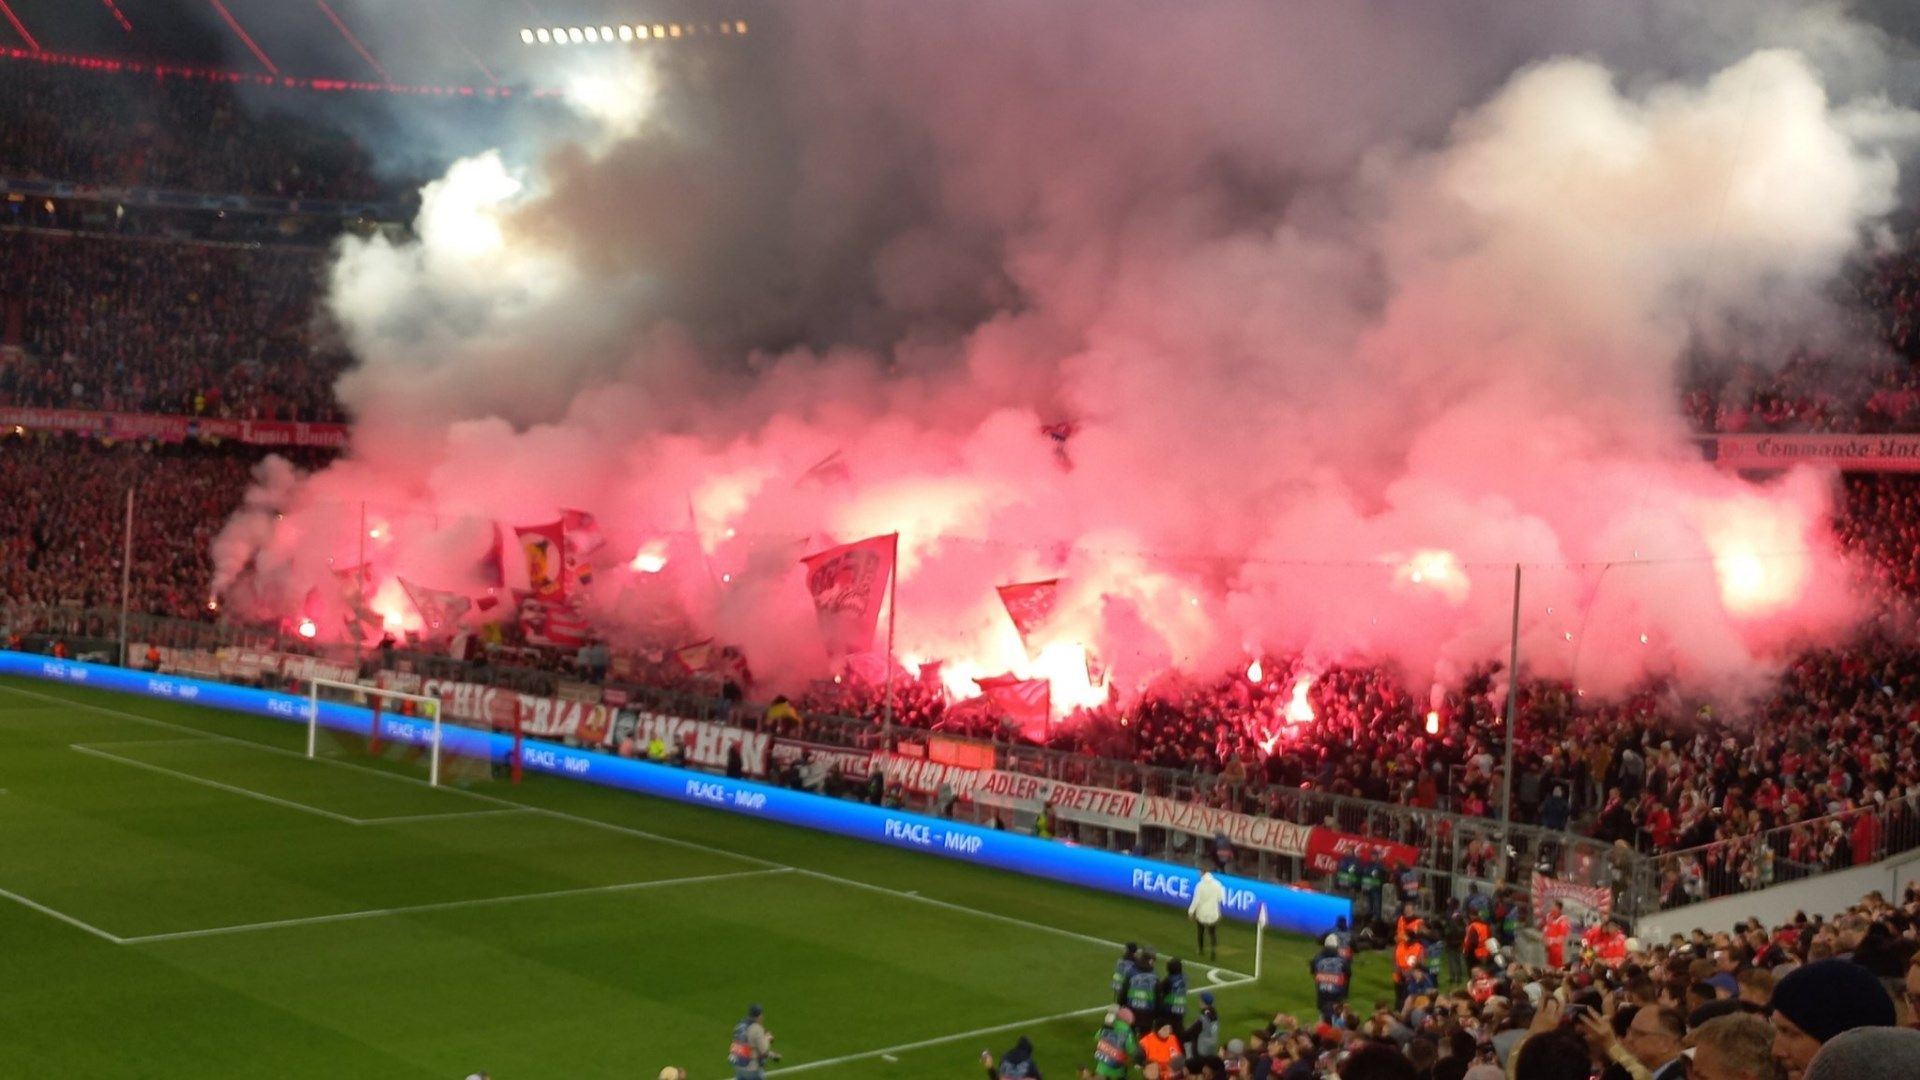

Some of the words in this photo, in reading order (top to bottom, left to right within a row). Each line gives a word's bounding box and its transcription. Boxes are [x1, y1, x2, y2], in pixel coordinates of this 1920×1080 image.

[525, 747, 555, 767] PEACE
[686, 779, 725, 801] PEACE
[981, 773, 1038, 799] ADLER
[1051, 785, 1136, 818] BRETTEN
[885, 818, 931, 844] PEACE
[944, 831, 983, 854] МИР
[1147, 801, 1306, 848] ANZENKIRCHEN
[1132, 868, 1190, 899] PEACE
